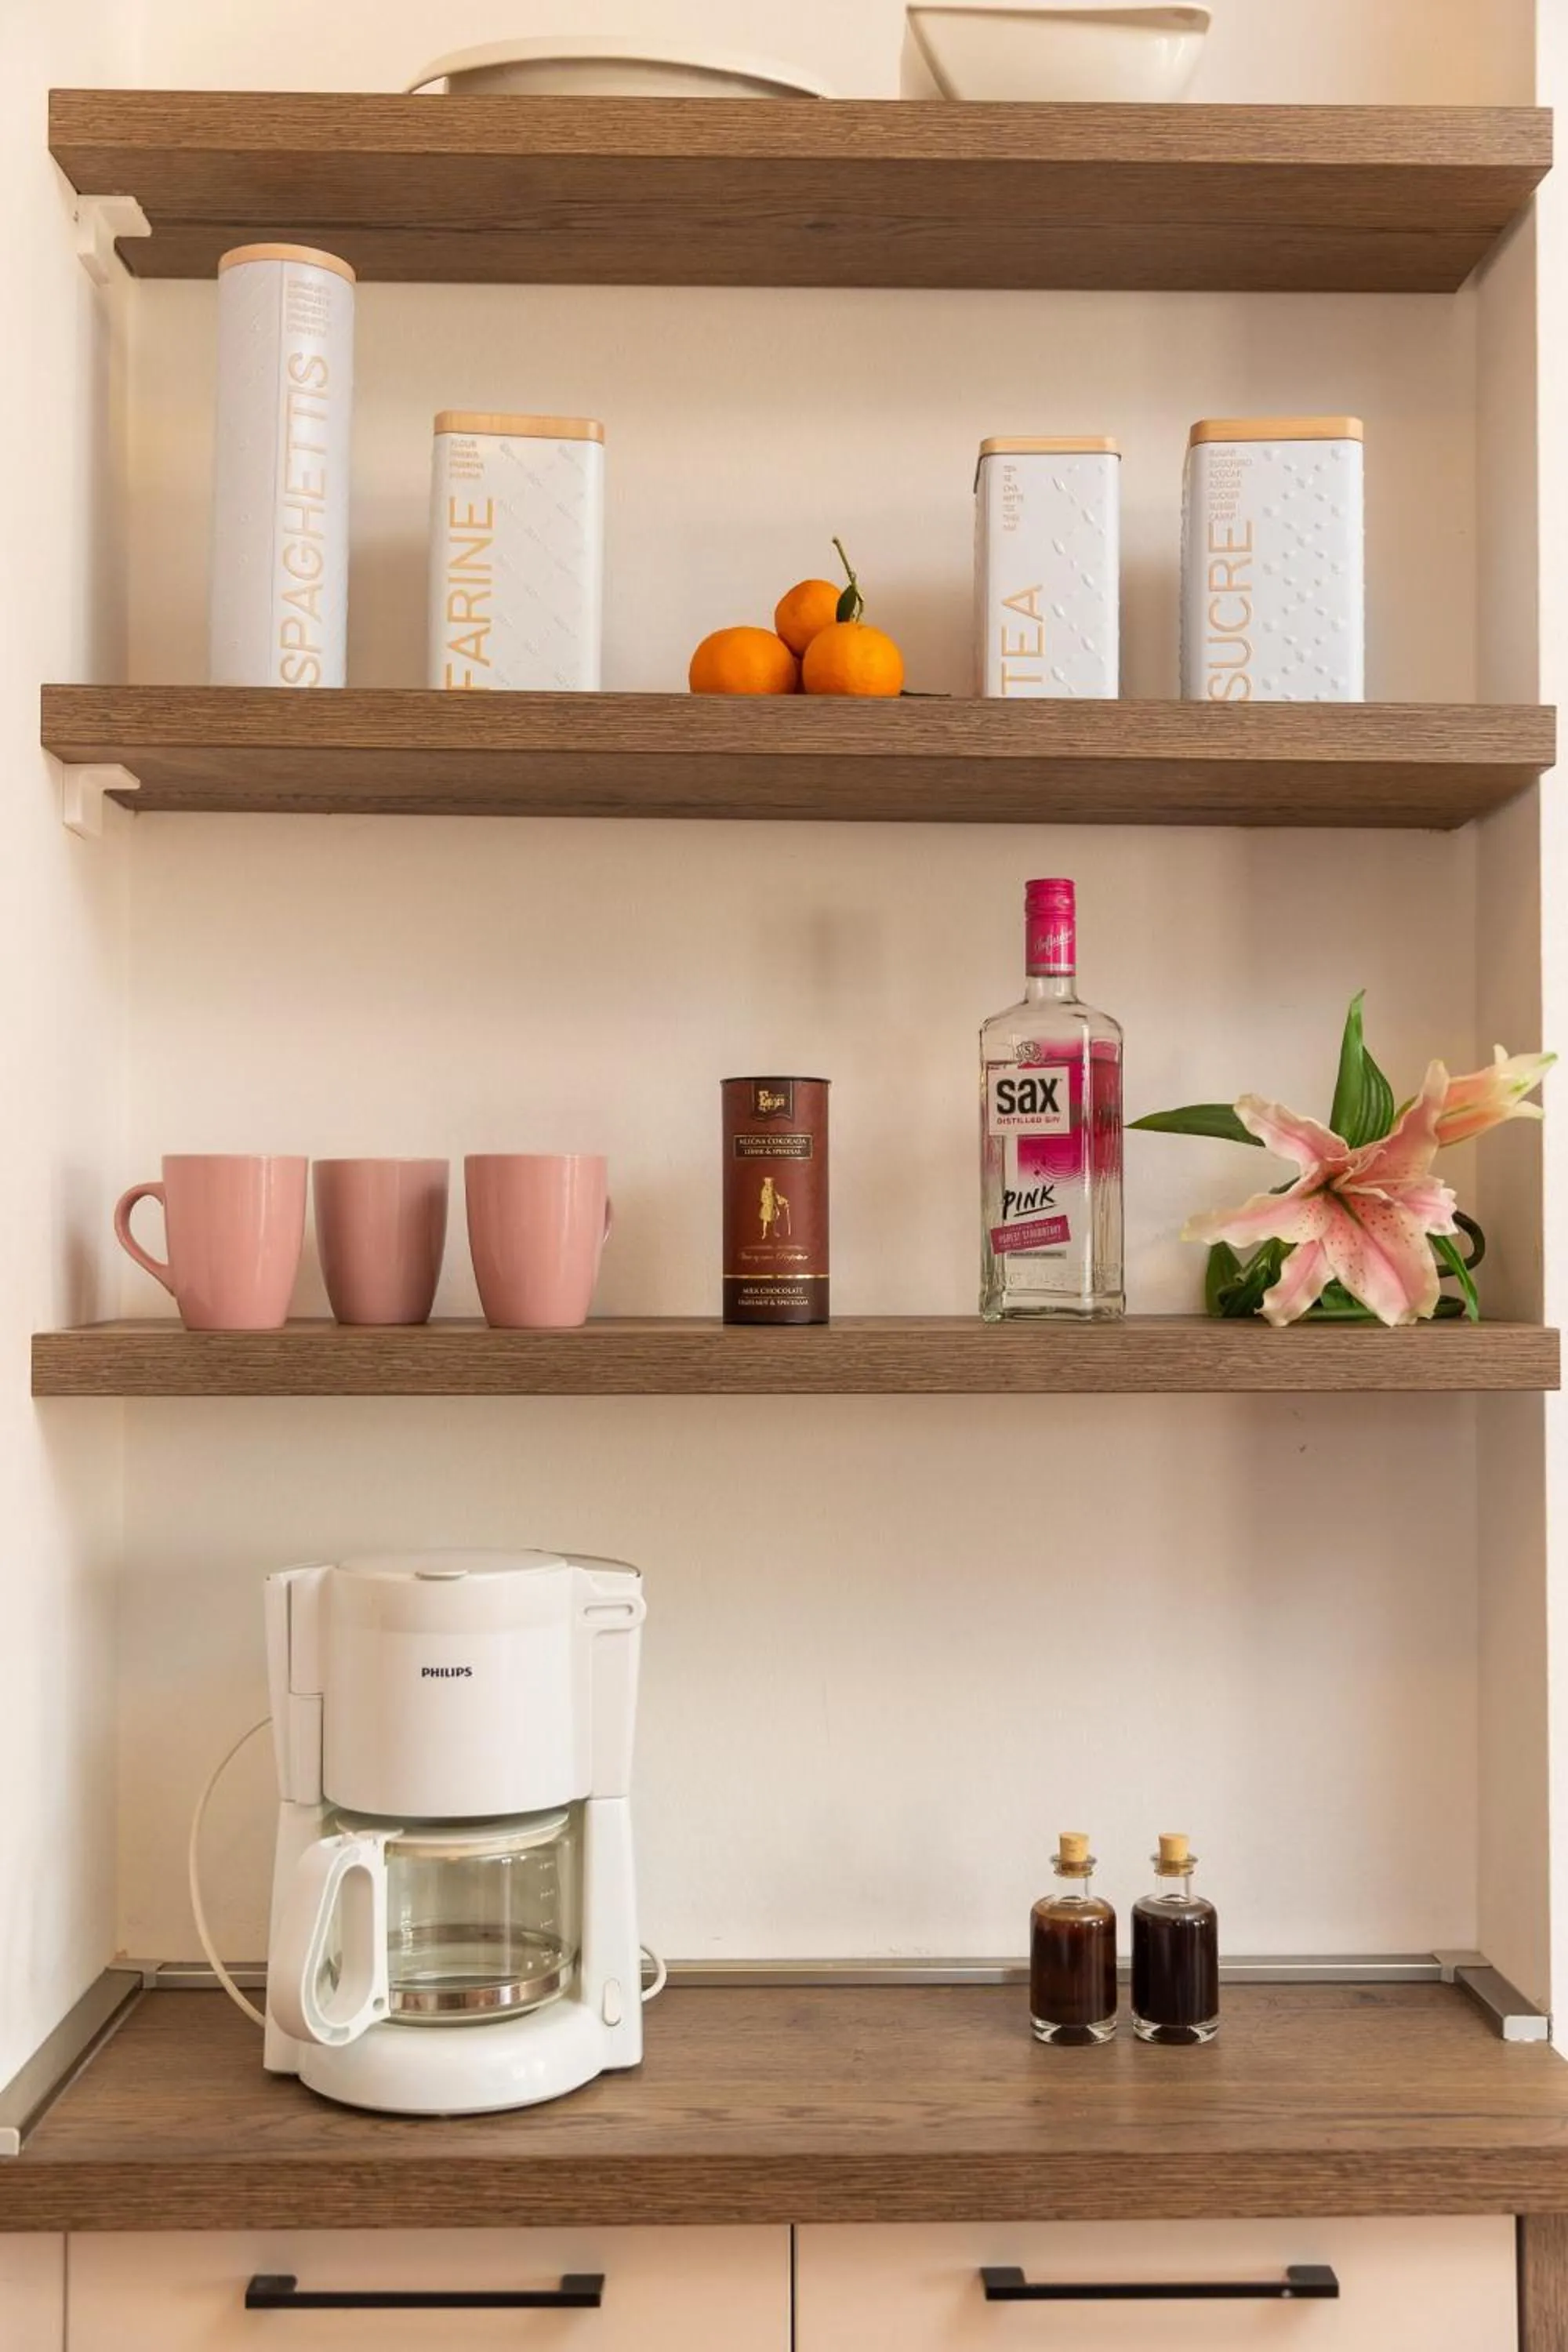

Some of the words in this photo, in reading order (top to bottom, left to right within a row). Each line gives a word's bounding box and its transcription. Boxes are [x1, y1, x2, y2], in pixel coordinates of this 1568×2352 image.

[279, 351, 329, 688] SPAGHETTIS
[446, 495, 493, 690] FARINE
[1207, 520, 1253, 702] SUCRE
[1001, 584, 1044, 696] TEA
[996, 1078, 1060, 1115] sax
[996, 1116, 1043, 1125] DISTILLED
[1002, 1185, 1055, 1220] PINK
[421, 1666, 473, 1679] PHILIPS
